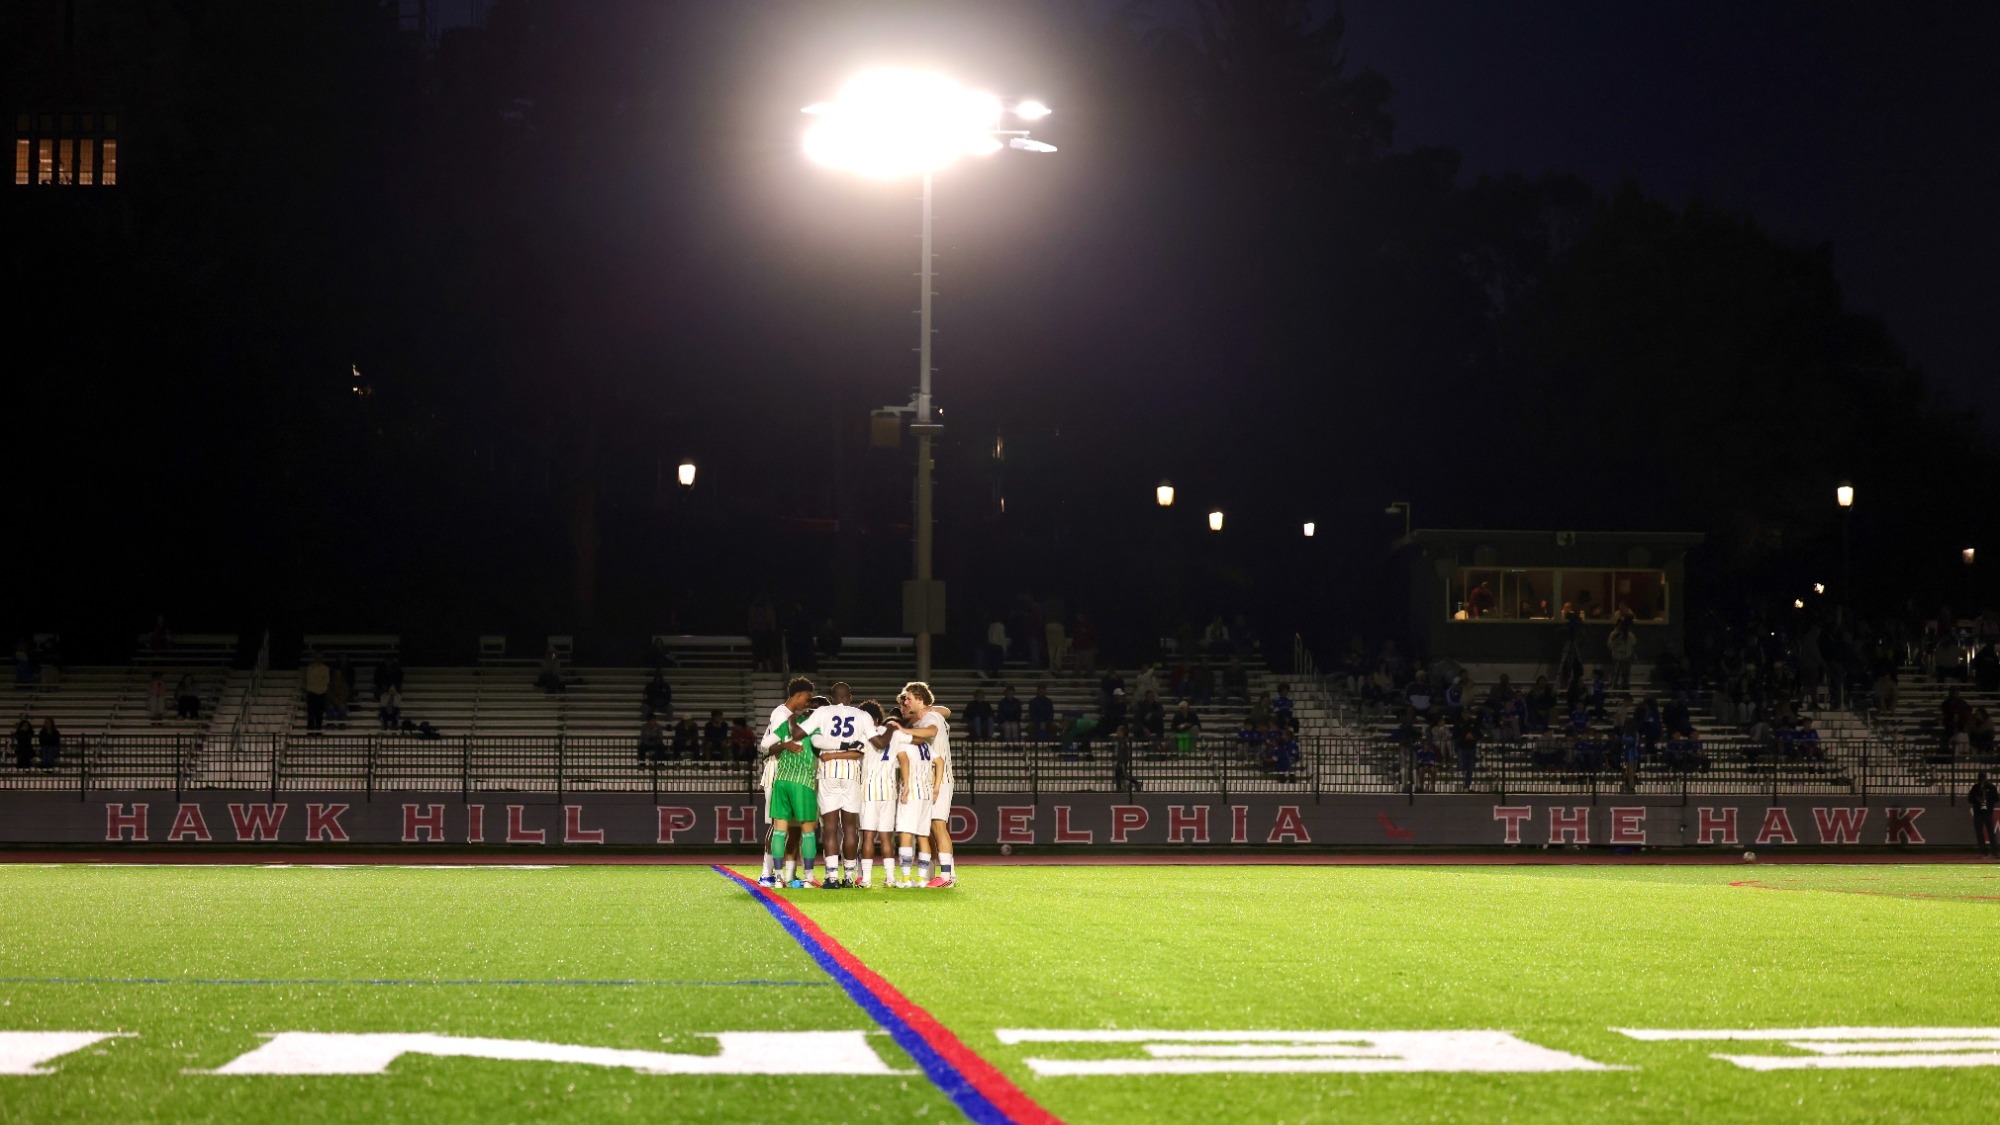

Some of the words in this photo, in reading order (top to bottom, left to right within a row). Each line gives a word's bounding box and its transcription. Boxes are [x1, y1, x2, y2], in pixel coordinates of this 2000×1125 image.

[830, 715, 855, 738] 35
[105, 803, 350, 842] HAWK
[402, 803, 604, 844] HILL
[656, 804, 1311, 845] PHDELPHIA
[1493, 805, 1647, 845] THE
[1698, 807, 1926, 845] HAWK
